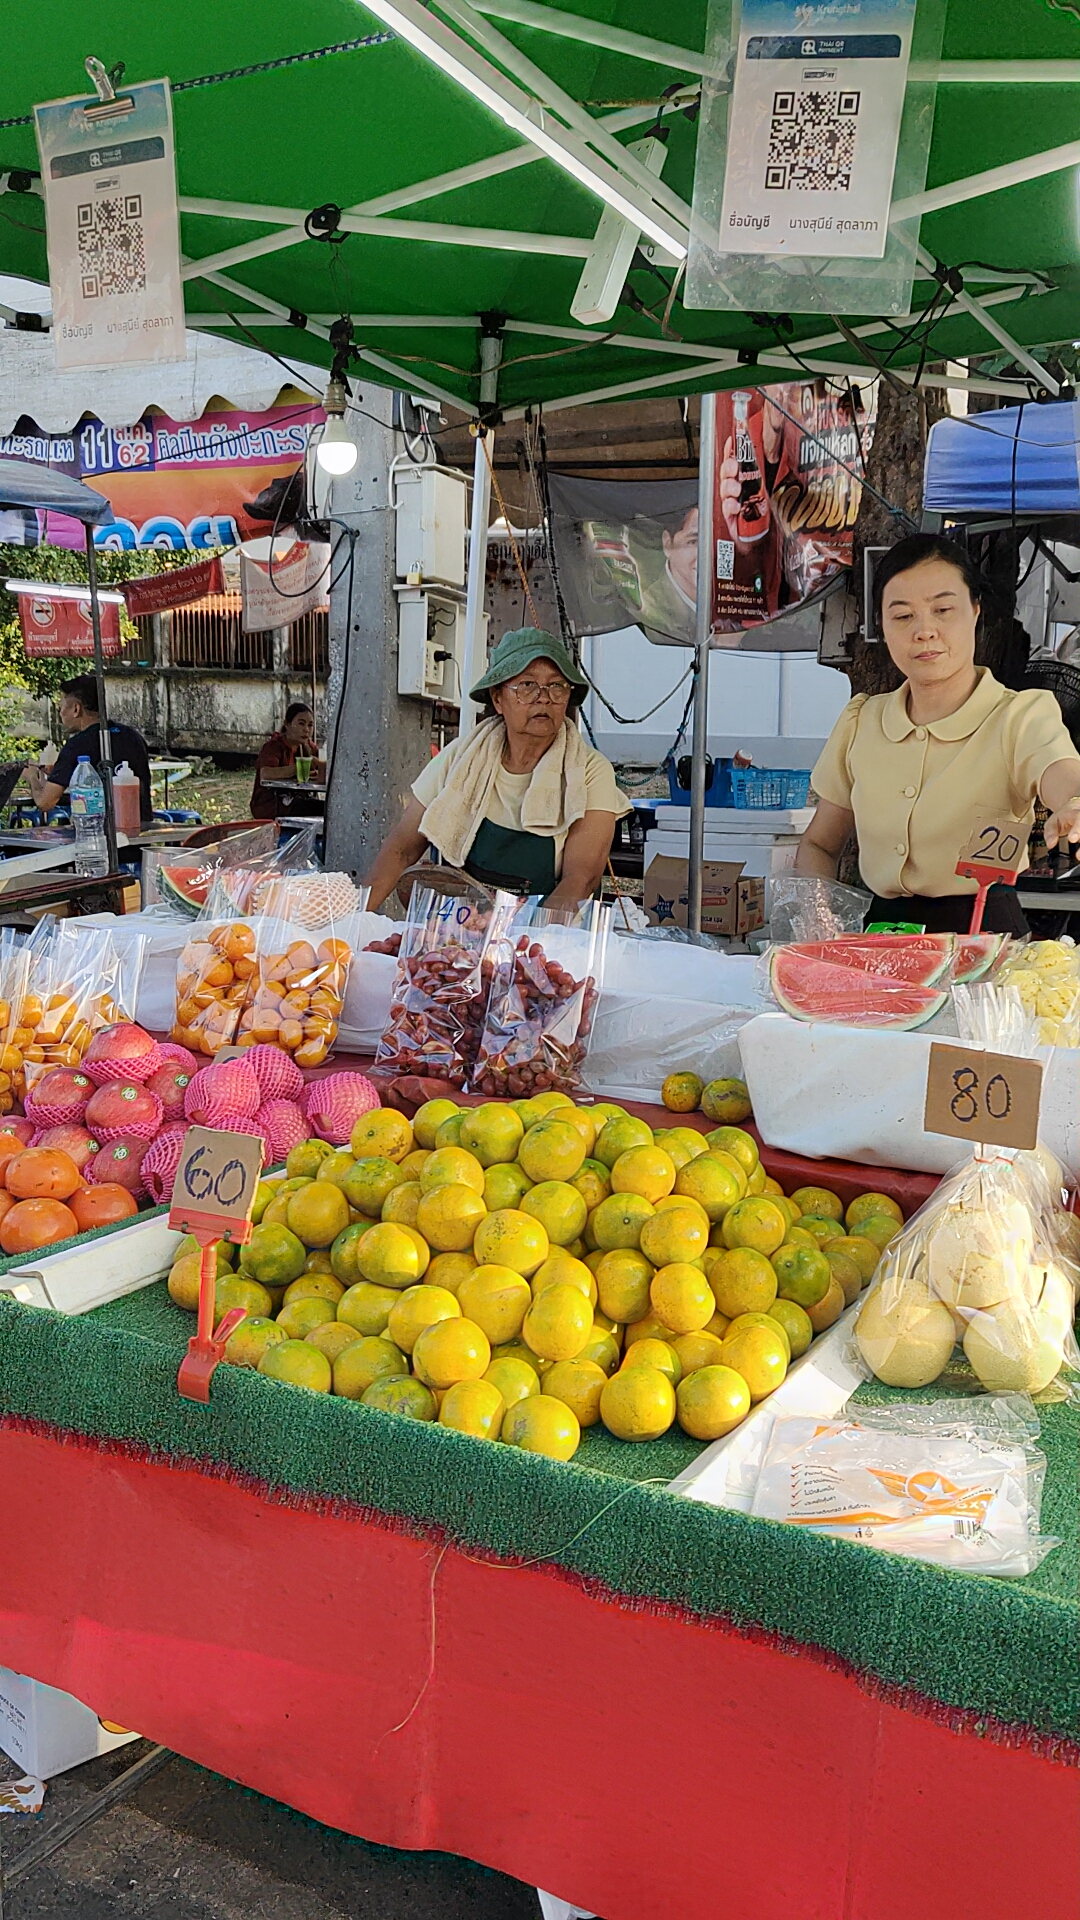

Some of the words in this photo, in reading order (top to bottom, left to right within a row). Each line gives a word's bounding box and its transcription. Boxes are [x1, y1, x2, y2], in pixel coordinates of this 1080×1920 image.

[729, 211, 770, 230] ชื่อบัญชี
[789, 217, 833, 233] นางสุนีย์
[836, 219, 878, 234] สุดลาภา
[83, 426, 113, 468] 11
[119, 444, 149, 465] 62
[178, 576, 195, 589] food
[971, 826, 1019, 862] 20
[426, 894, 471, 925] 140
[951, 1067, 1012, 1122] 80
[184, 1145, 246, 1206] 60
